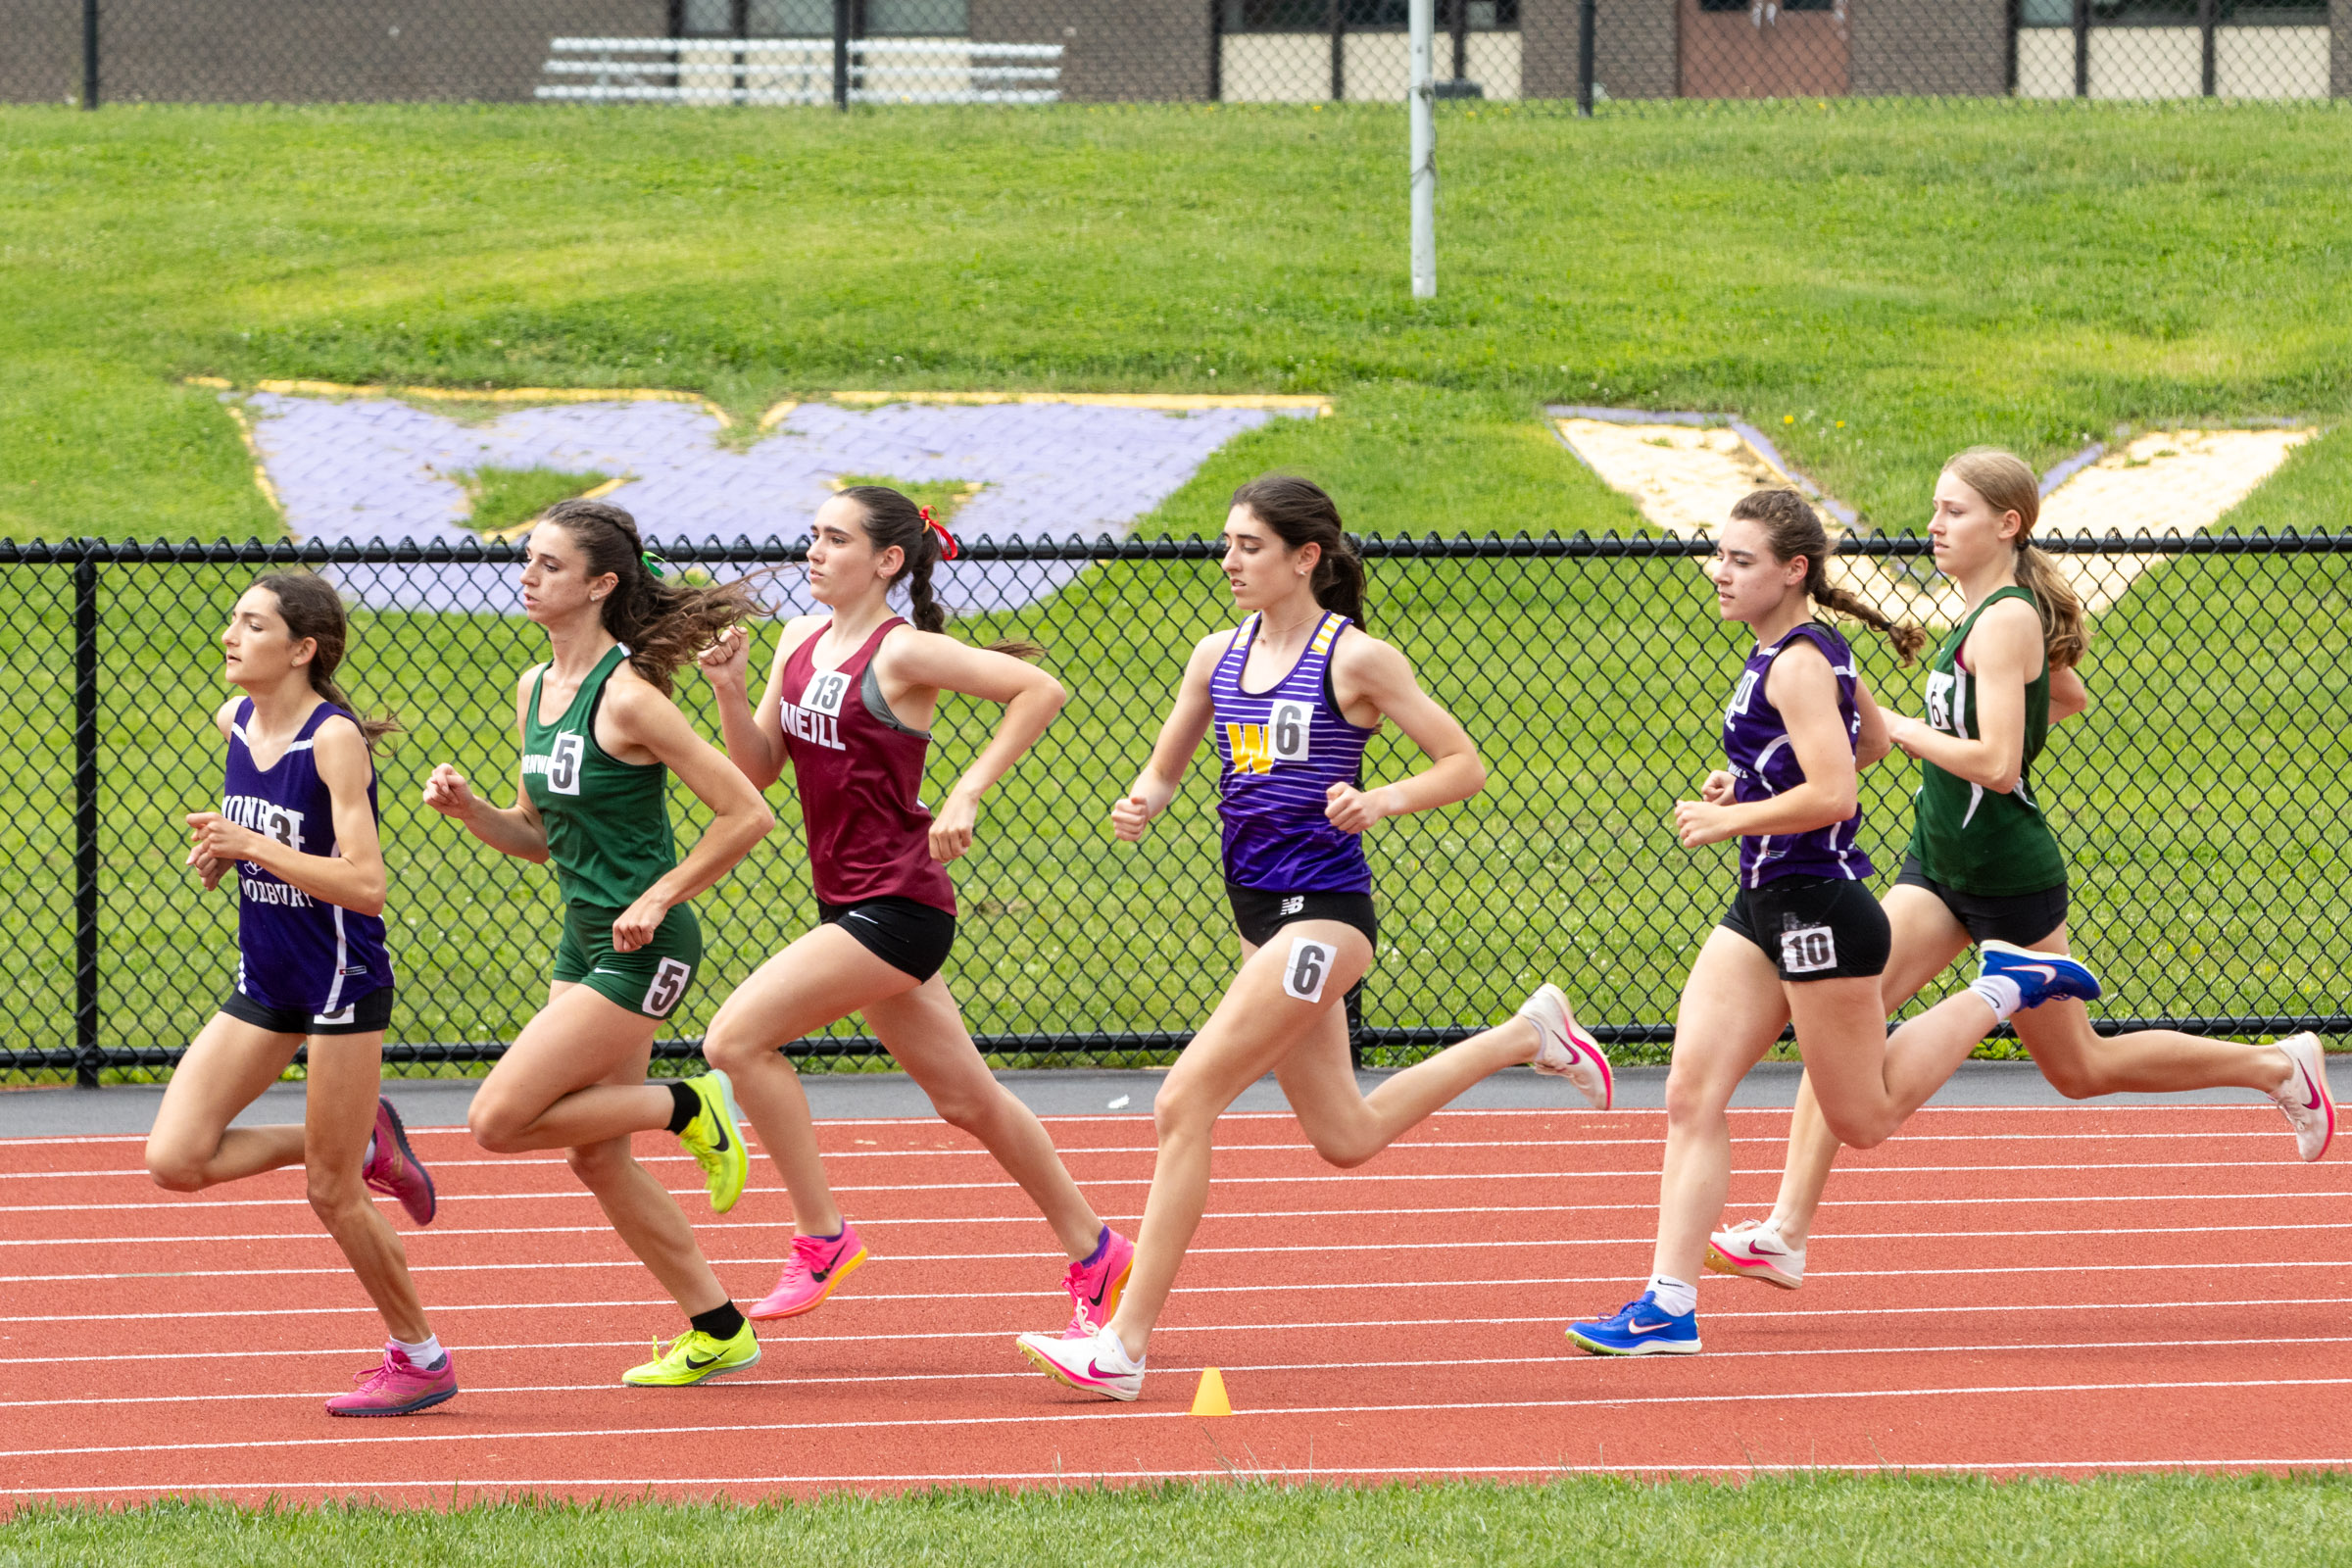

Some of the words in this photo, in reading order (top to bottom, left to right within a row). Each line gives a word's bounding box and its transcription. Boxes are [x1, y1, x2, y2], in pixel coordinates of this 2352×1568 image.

[811, 675, 843, 710] 13
[1225, 722, 1275, 775] W
[1276, 705, 1301, 756] 6
[553, 739, 575, 789] 5
[221, 795, 305, 852] ONRE
[270, 812, 292, 849] 3
[1293, 945, 1325, 996] 6
[1788, 932, 1832, 967] 10
[651, 963, 684, 1012] 5
